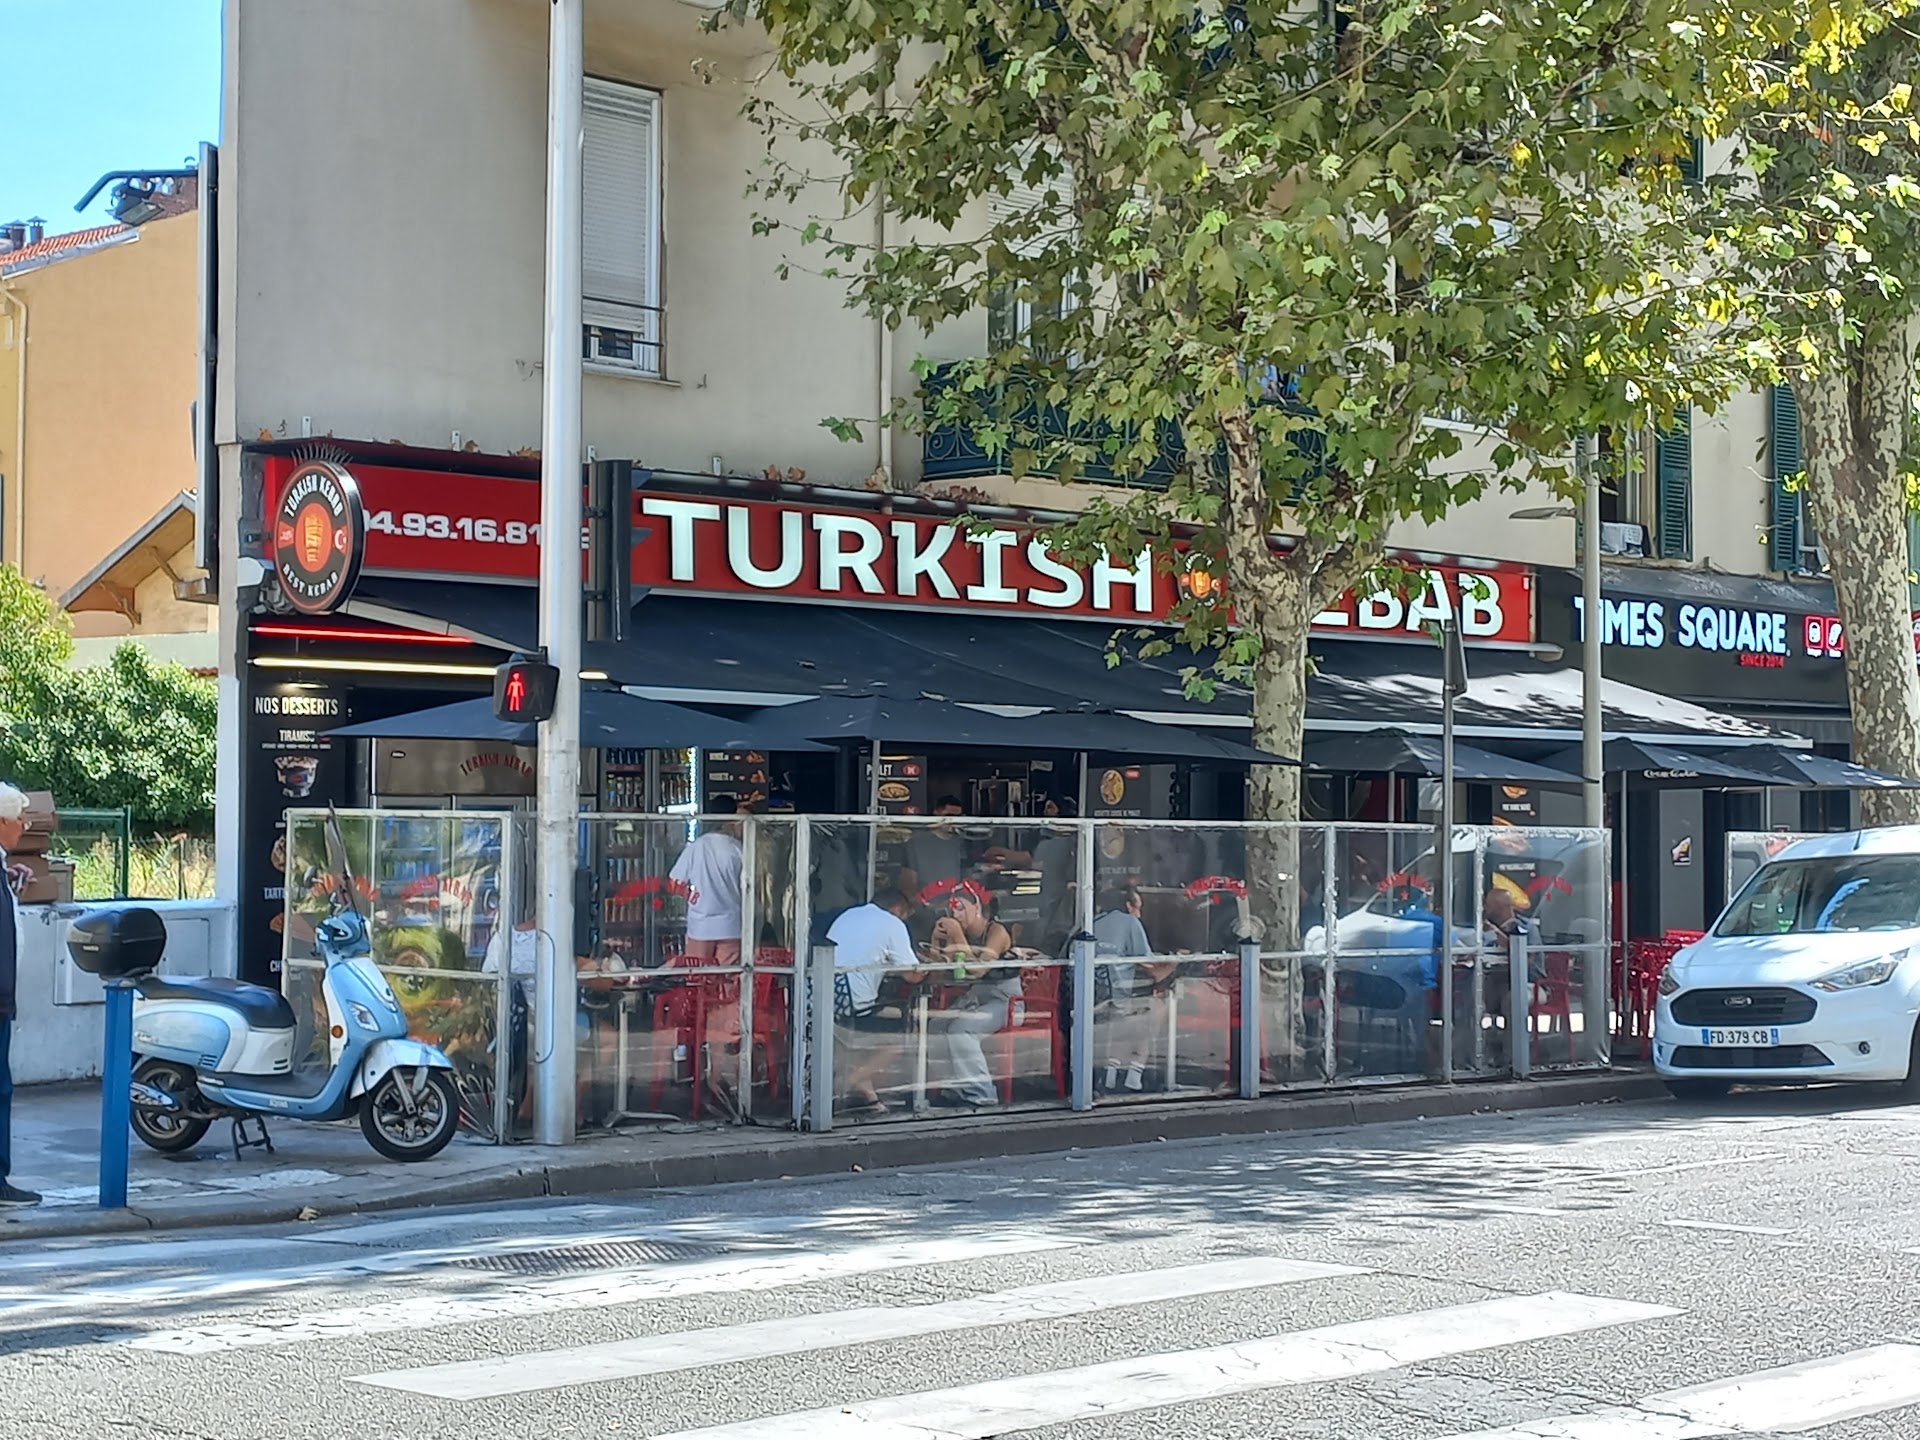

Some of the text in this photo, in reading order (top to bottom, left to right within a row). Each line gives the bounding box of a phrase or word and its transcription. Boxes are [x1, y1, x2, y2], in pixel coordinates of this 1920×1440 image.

[284, 474, 344, 518] TURKISH KEBAB
[642, 497, 1153, 612] TURKISH
[282, 562, 339, 597] BEST KEBAB
[1678, 604, 1787, 654] SQUARE
[255, 696, 339, 716] NOS DESSERTS
